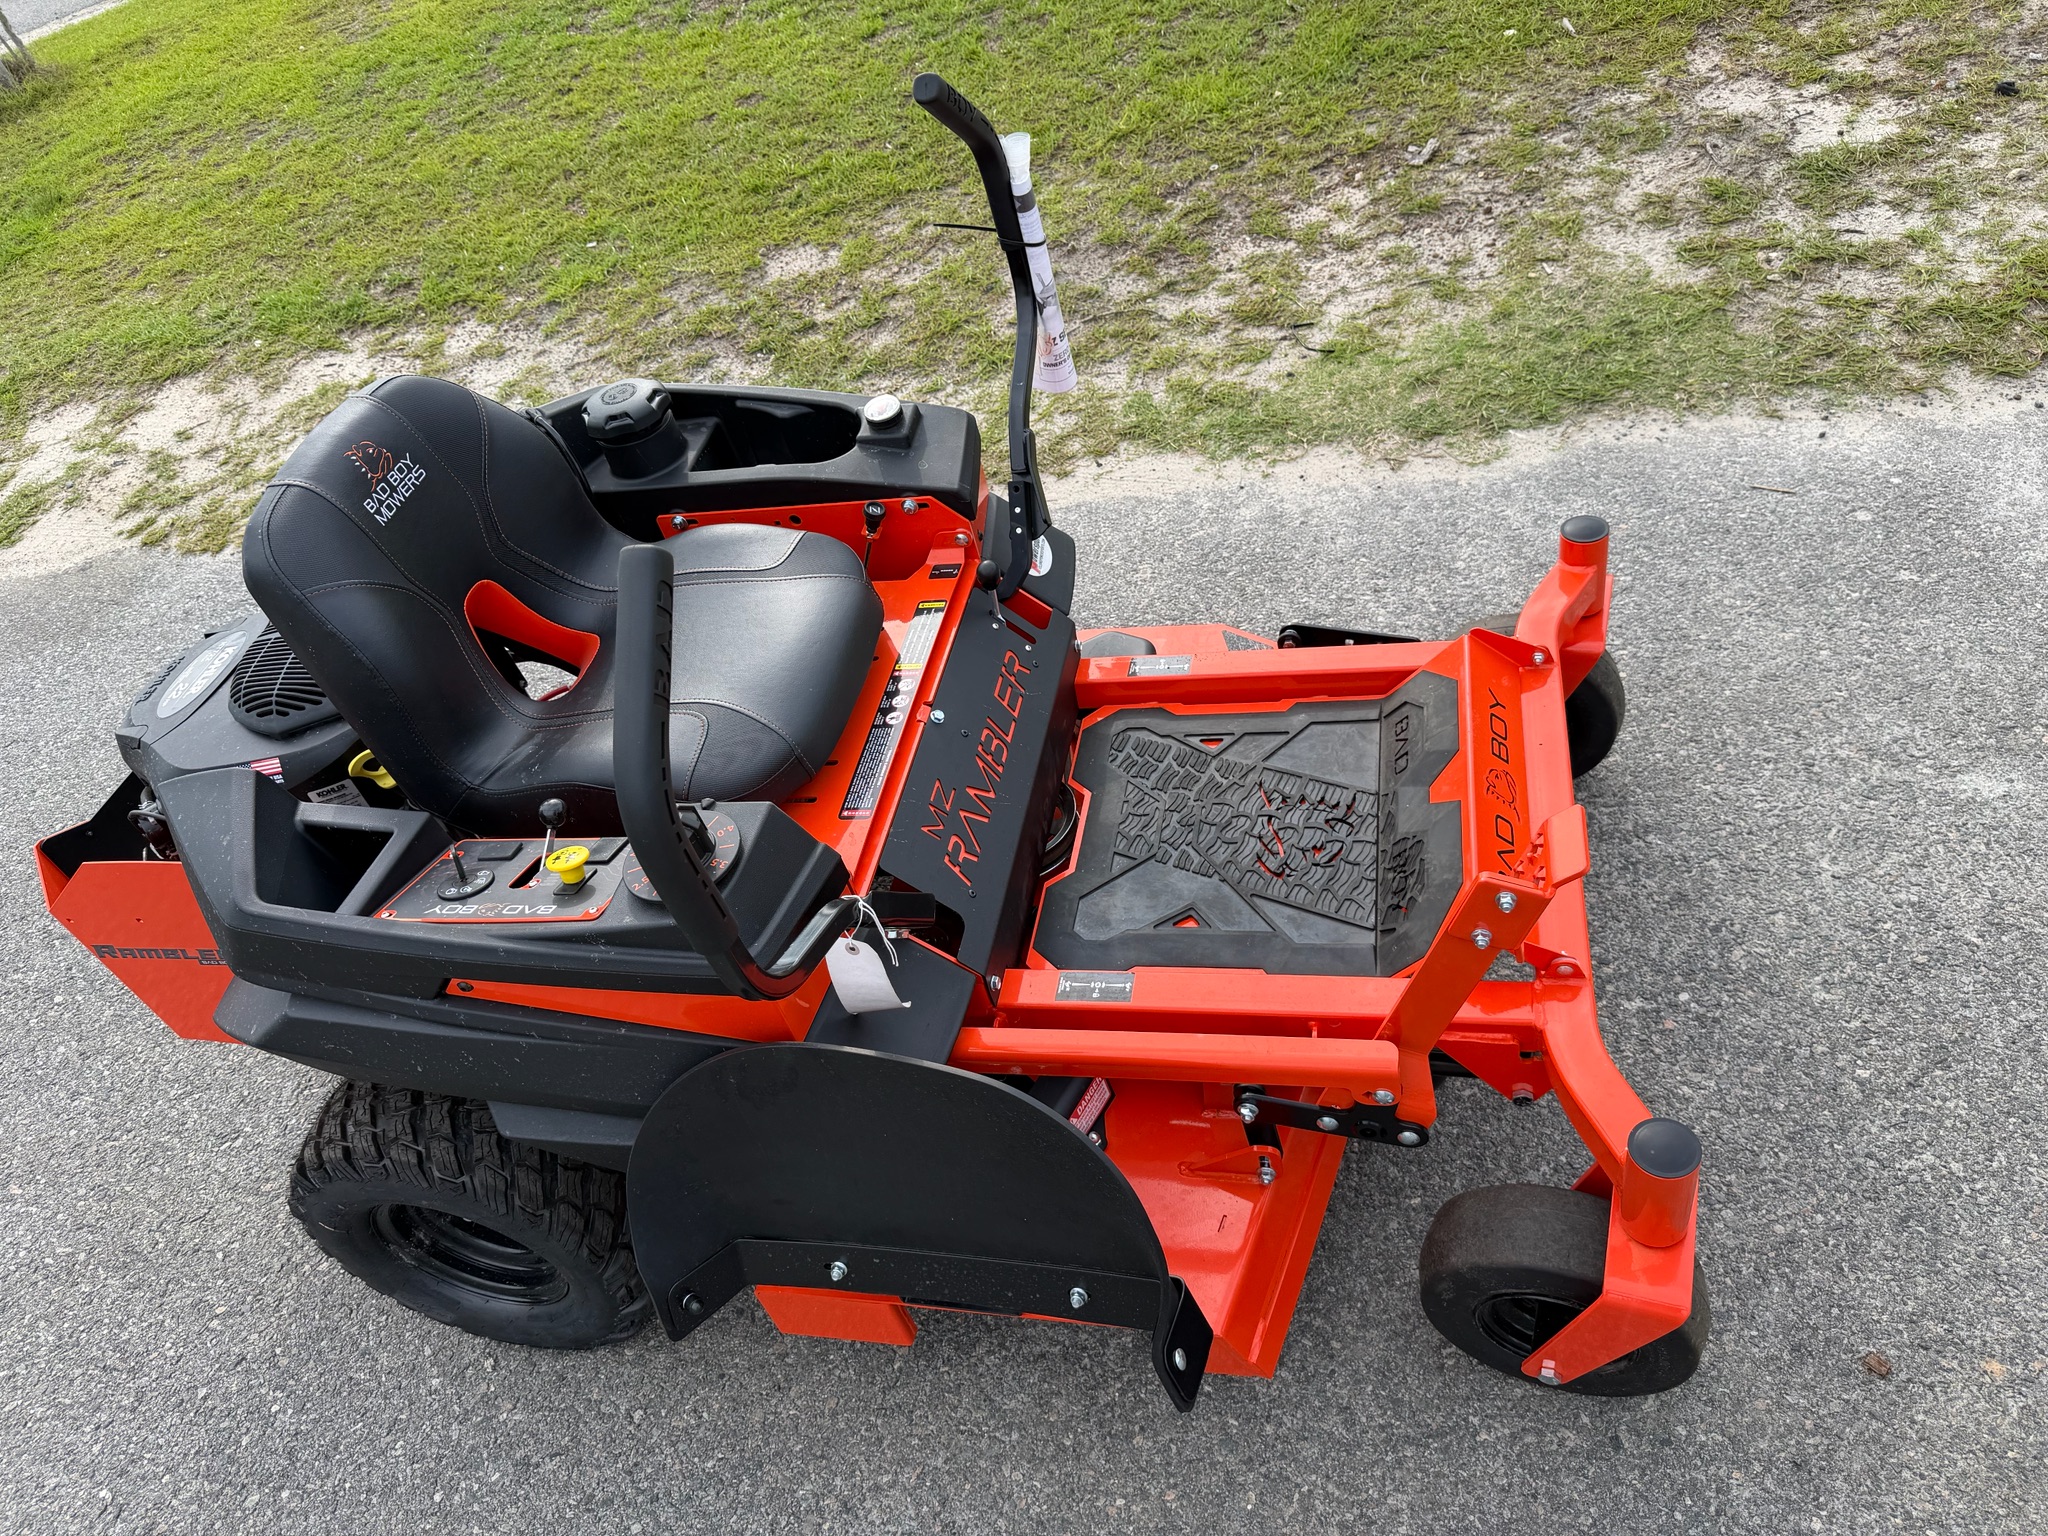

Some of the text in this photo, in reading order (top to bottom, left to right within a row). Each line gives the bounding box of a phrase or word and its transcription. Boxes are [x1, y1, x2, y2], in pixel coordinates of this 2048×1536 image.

[363, 452, 414, 514] BAD BOY
[373, 464, 427, 527] MOWERS
[183, 644, 239, 700] KOHLER
[942, 649, 1032, 887] RAMBLER
[1394, 714, 1410, 776] BAD
[315, 783, 348, 798] KOHLER
[920, 777, 957, 841] MZ
[1487, 686, 1517, 877] AD BOY
[716, 824, 735, 837] 4.0
[631, 876, 650, 891] 2.5
[709, 858, 729, 869] 3.5
[423, 904, 558, 915] BAD BOY
